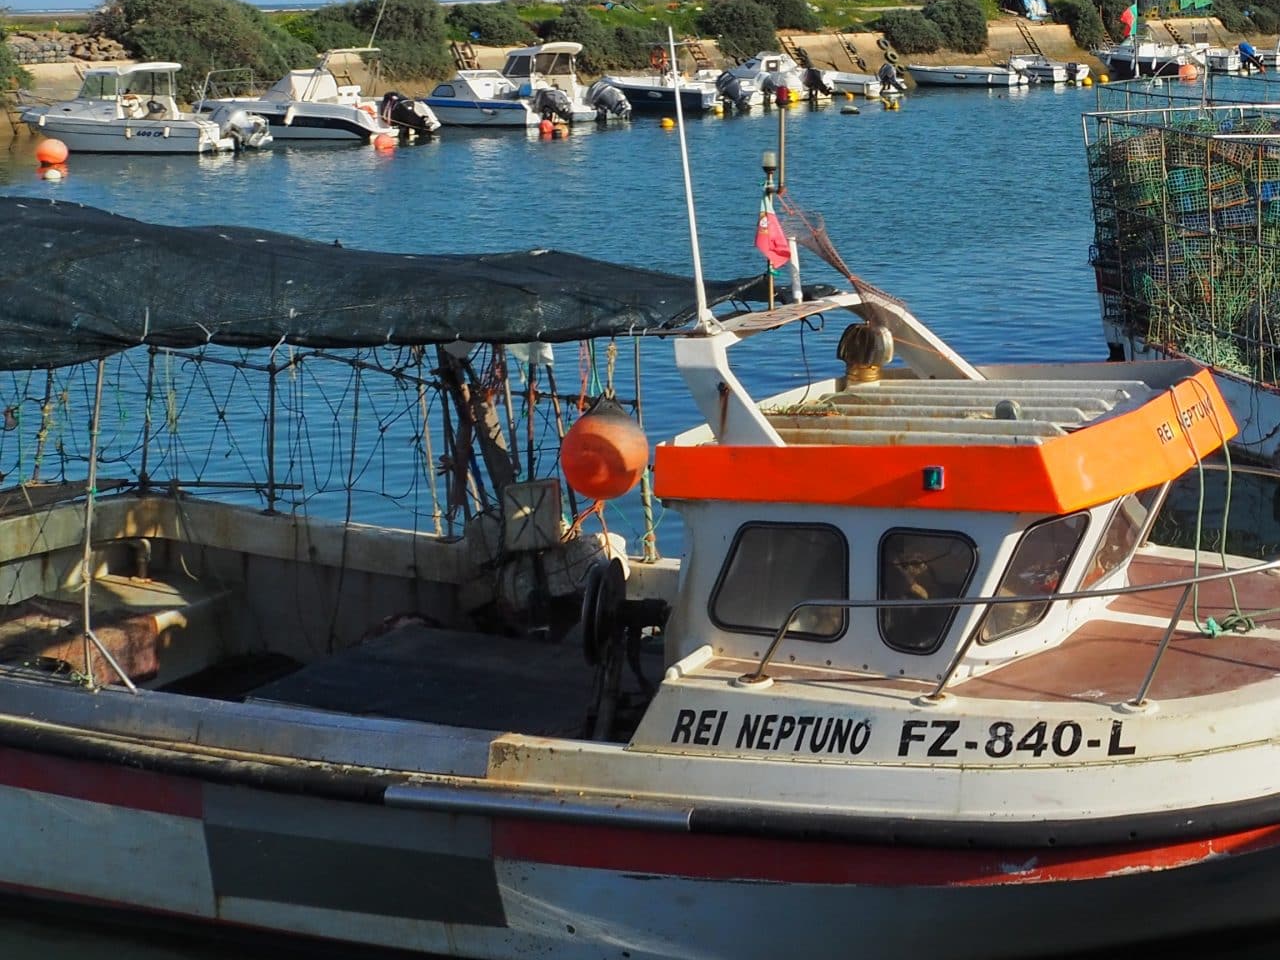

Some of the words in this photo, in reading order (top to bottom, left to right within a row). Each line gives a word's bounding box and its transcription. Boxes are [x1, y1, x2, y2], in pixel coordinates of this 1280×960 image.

[1156, 421, 1175, 445] REI
[671, 709, 729, 746] REI
[735, 713, 873, 755] NEPTUNO
[897, 719, 1137, 758] FZ-840-L
